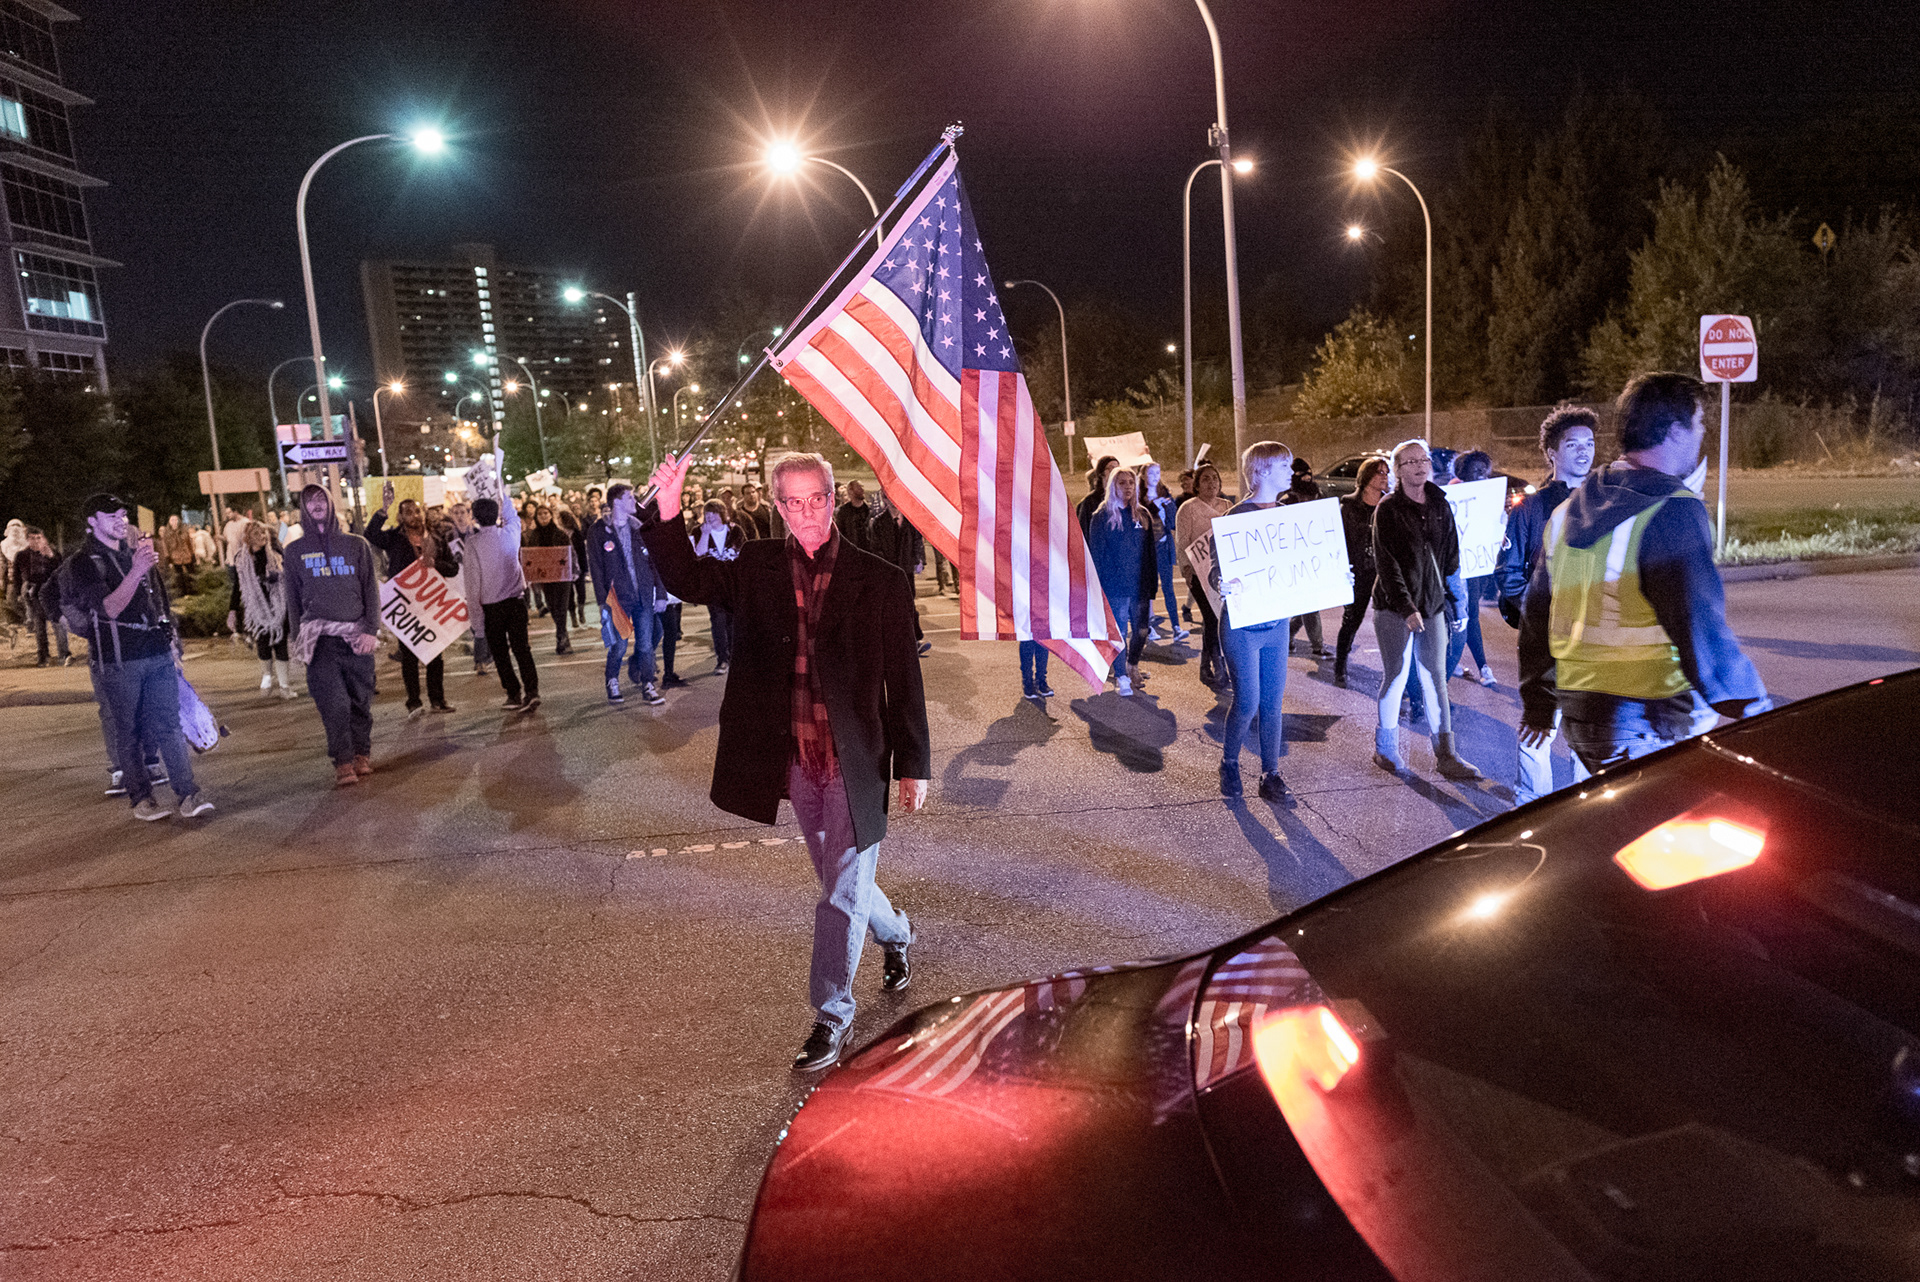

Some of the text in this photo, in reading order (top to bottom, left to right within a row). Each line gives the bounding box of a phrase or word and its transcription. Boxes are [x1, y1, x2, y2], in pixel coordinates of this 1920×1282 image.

[1709, 327, 1749, 340] DO NOT
[1712, 358, 1745, 370] ENTER
[301, 447, 343, 459] ONE WAY
[1221, 517, 1336, 563] IMPEACH
[393, 556, 469, 627] DUMP
[1244, 555, 1321, 595] TRUMP
[381, 586, 437, 647] TRUMP
